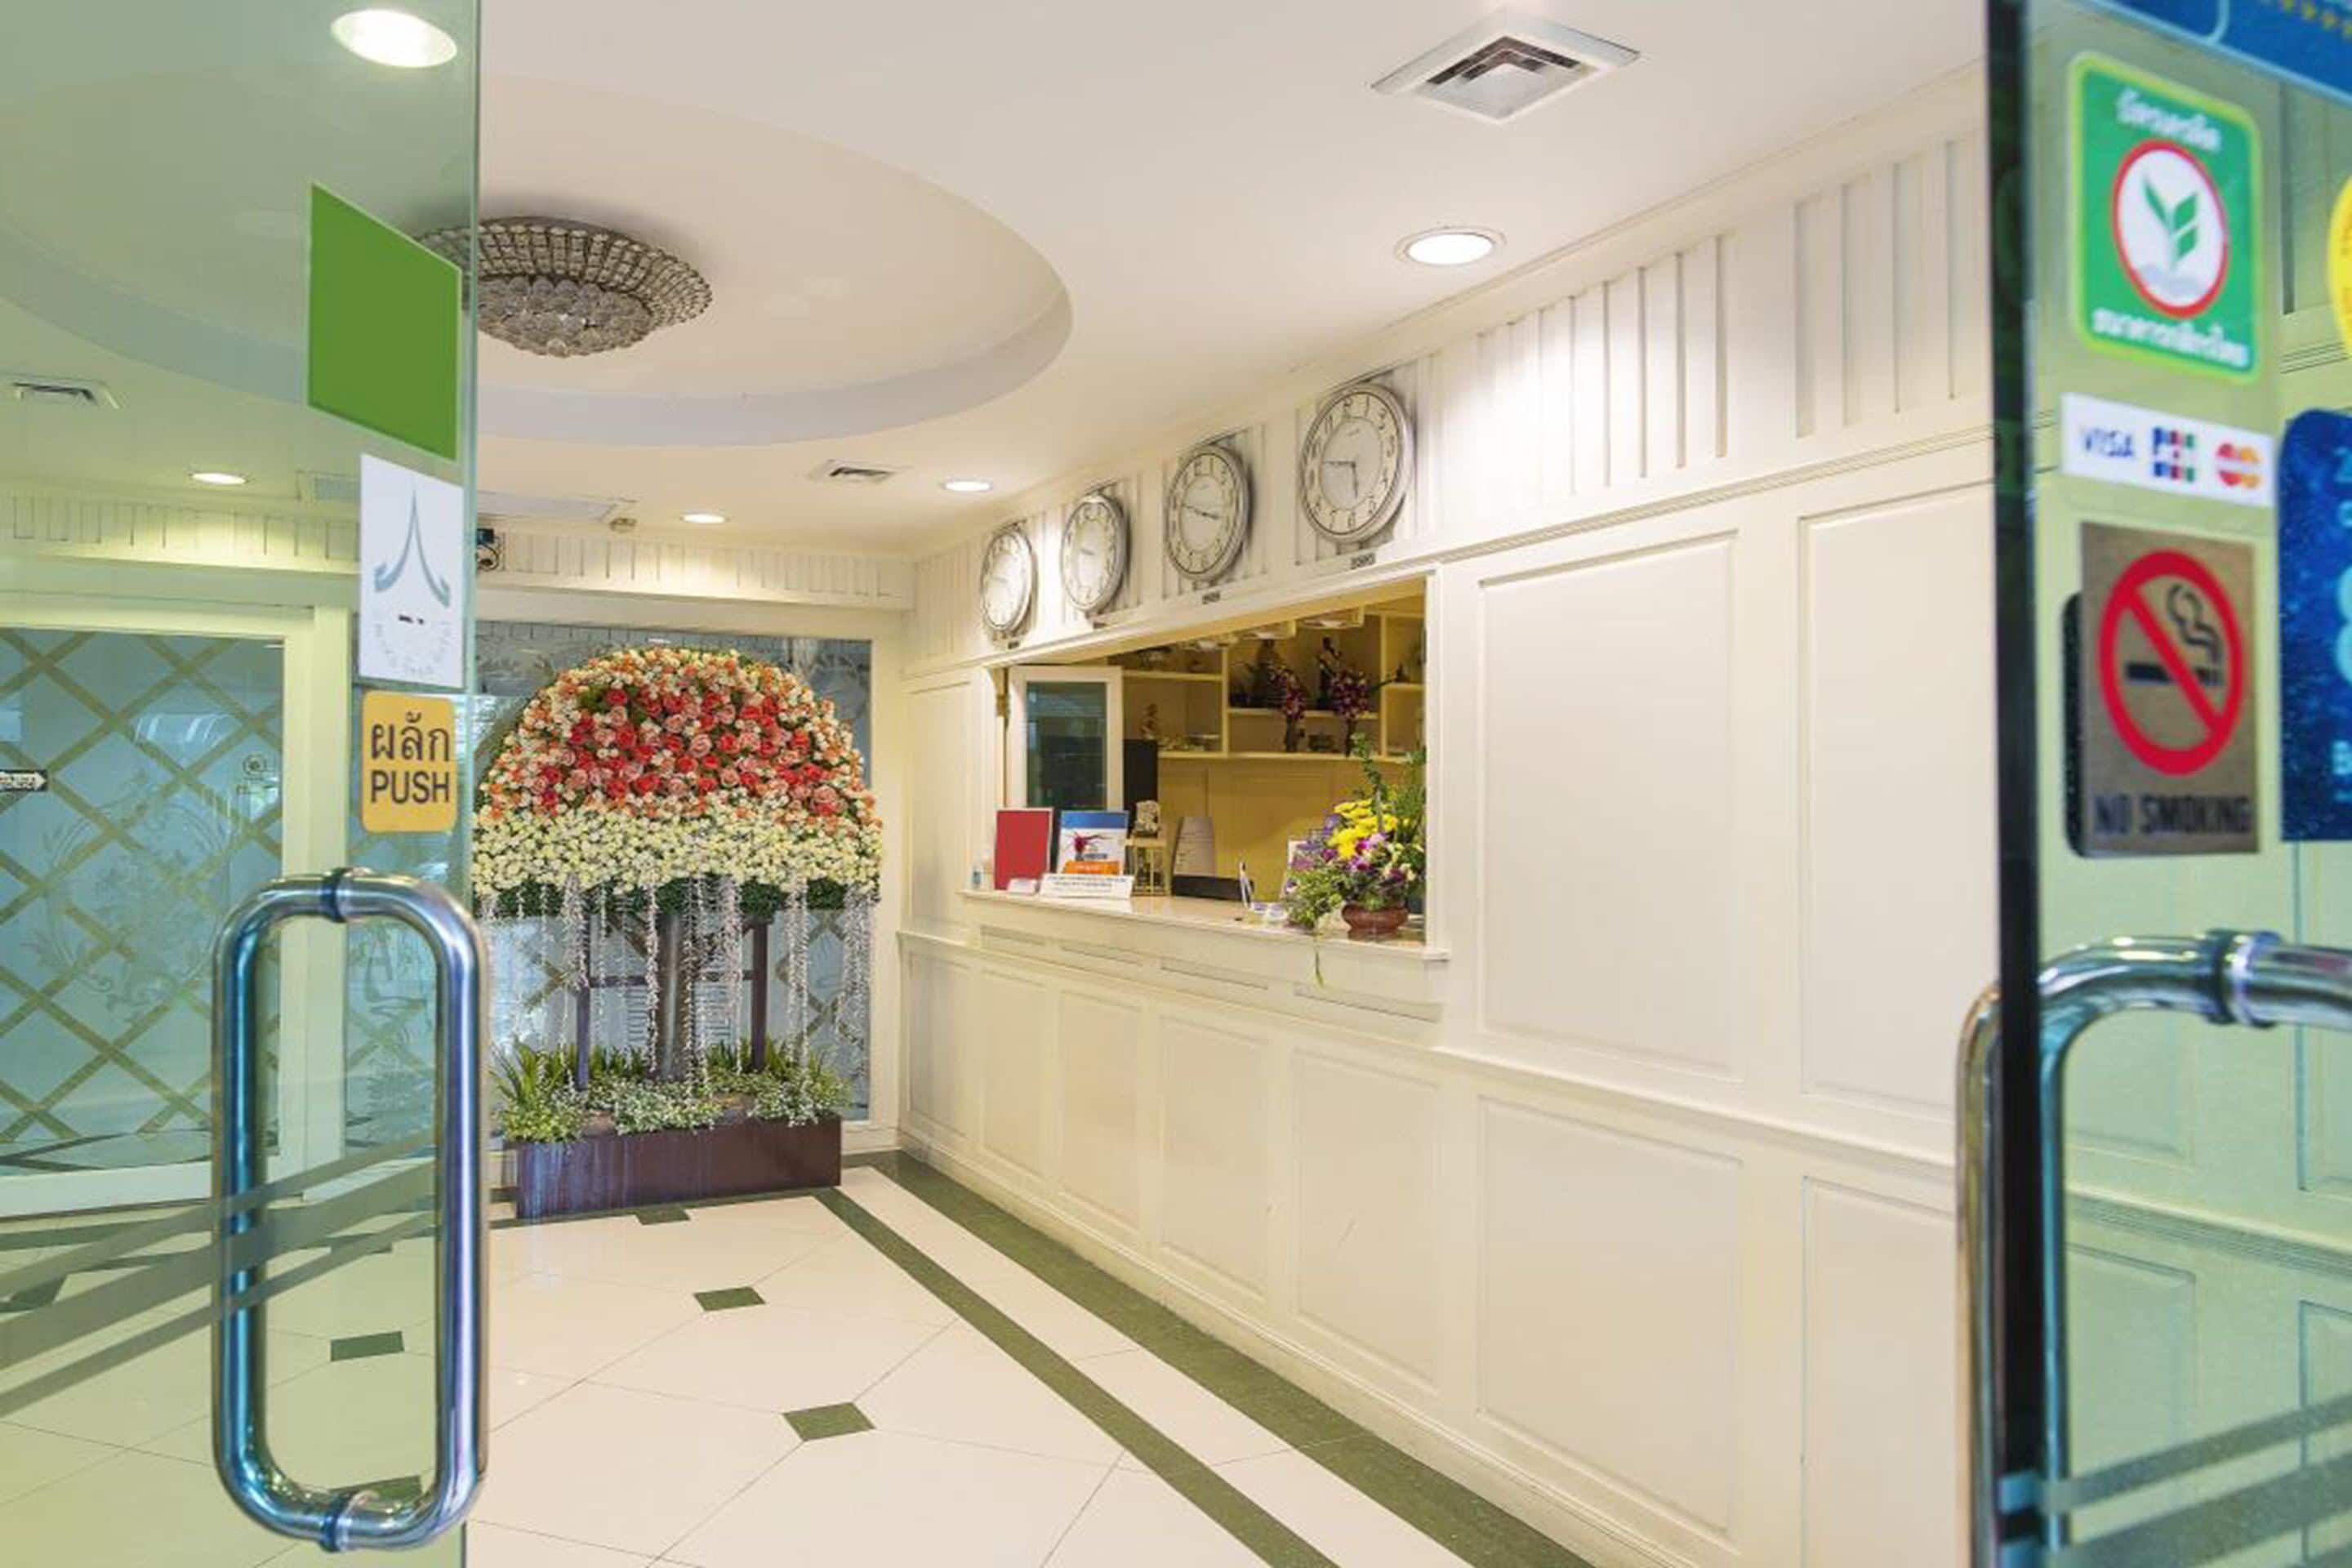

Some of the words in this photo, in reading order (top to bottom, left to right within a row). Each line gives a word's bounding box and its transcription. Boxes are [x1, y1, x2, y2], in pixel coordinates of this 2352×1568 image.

[372, 710, 449, 762] ผลัก
[371, 770, 449, 804] PUSH
[2094, 795, 2131, 835] NO
[2140, 795, 2252, 835] SMOKING
